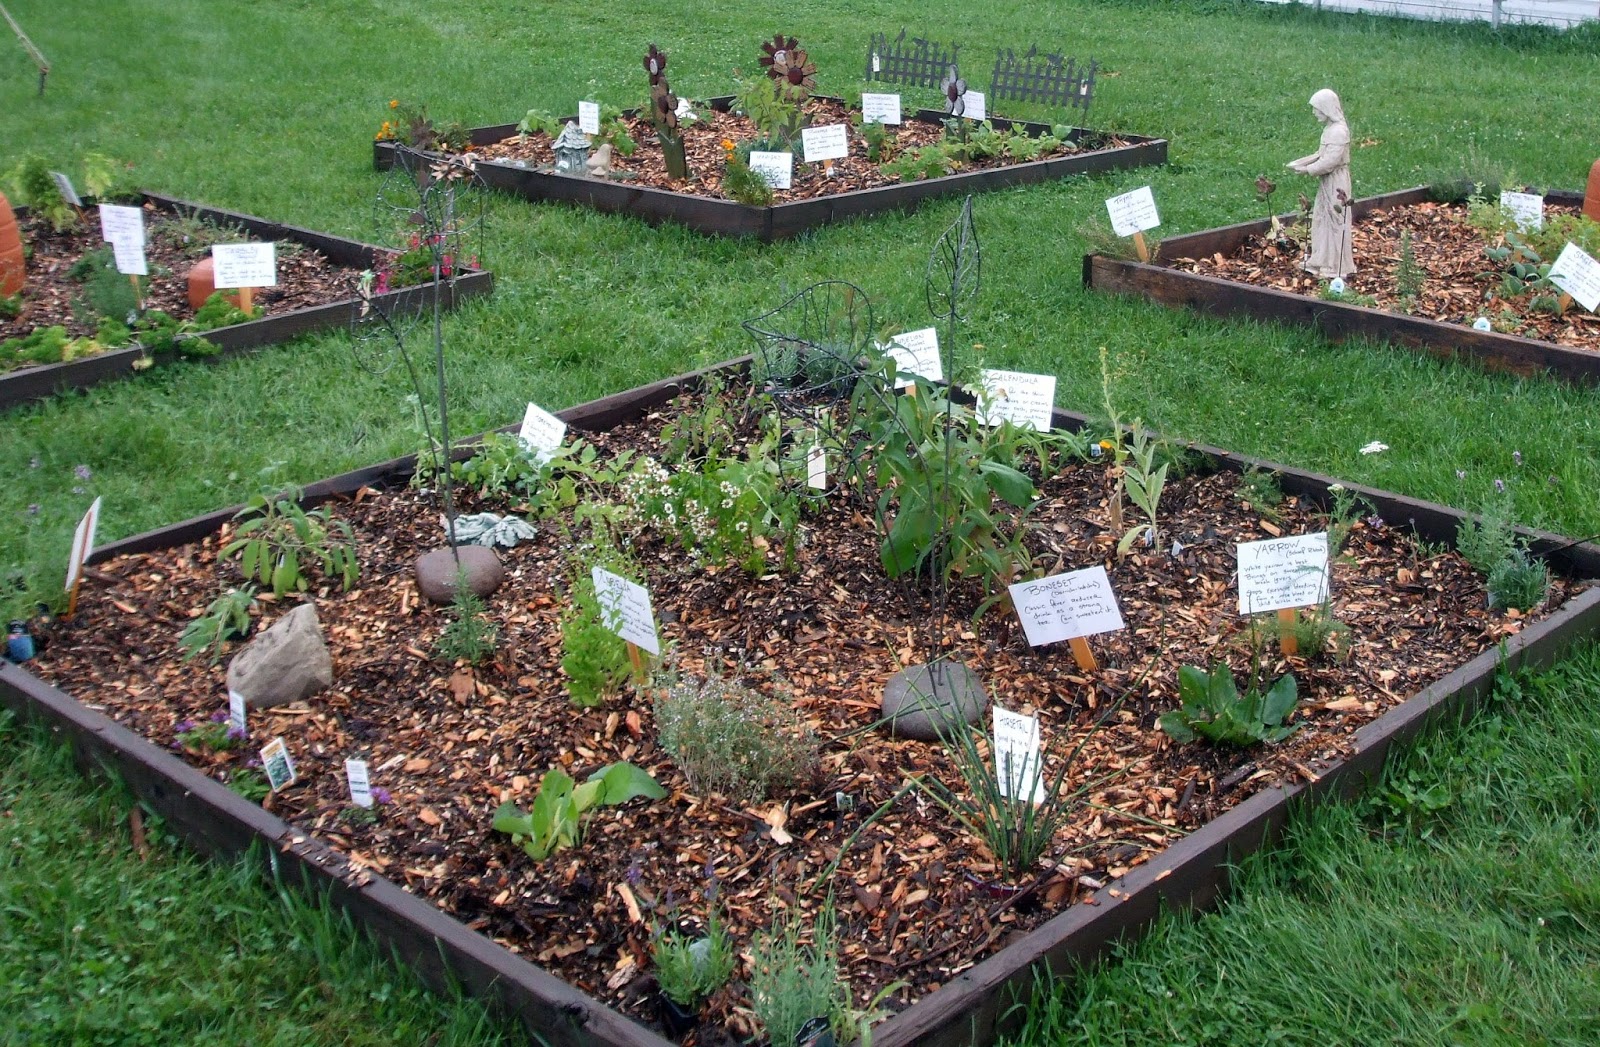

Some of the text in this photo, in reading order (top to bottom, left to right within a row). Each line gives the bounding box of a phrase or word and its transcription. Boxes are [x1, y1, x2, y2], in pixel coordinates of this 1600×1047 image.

[1253, 540, 1300, 559] YARROW
[1023, 577, 1077, 596] BONESET
[1024, 604, 1046, 614] Classic
[1050, 599, 1065, 608] fever
[1060, 615, 1072, 624] Can
[1076, 610, 1103, 619] sweeten
